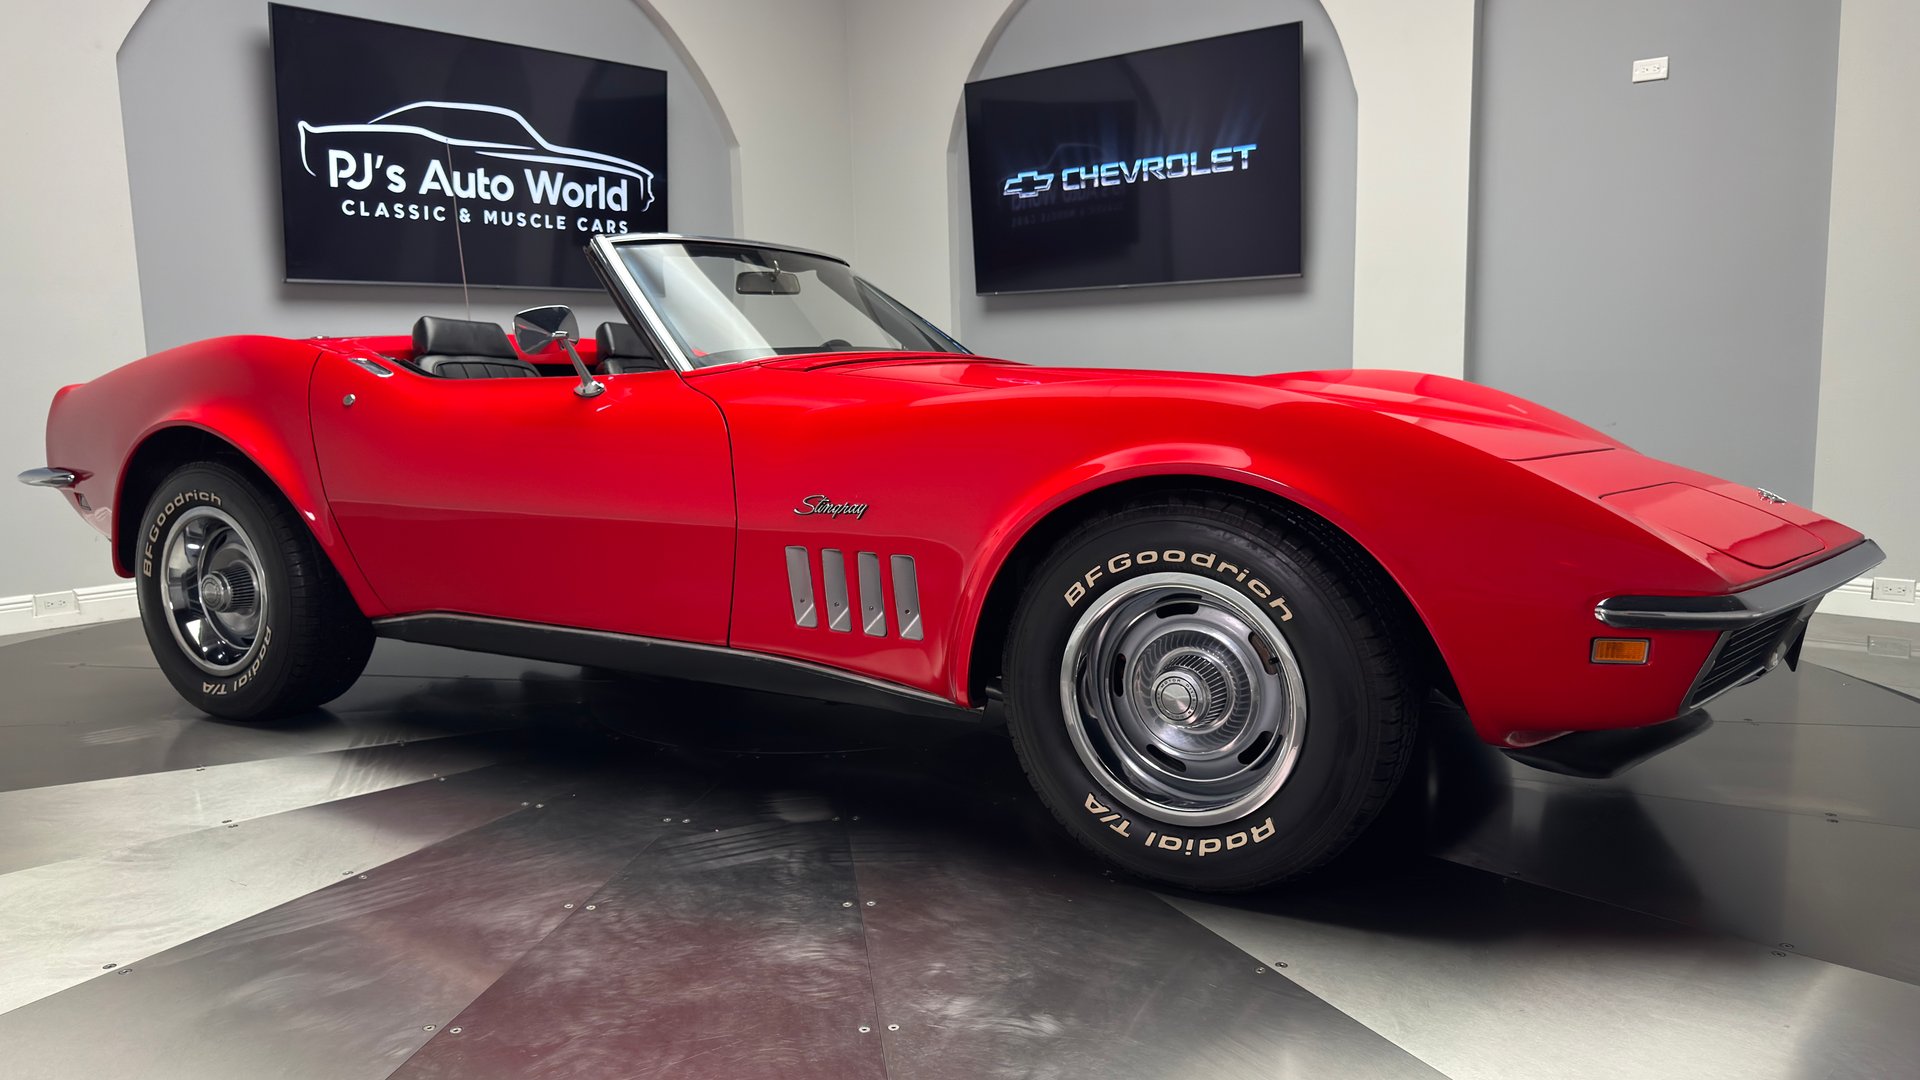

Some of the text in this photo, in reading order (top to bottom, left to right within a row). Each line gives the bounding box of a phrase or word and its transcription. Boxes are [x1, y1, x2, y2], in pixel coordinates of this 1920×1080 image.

[328, 149, 628, 212] PJ's Auto World
[1062, 144, 1257, 191] CHEVROLET
[341, 199, 628, 234] CLASSIC & MUSCLE CARS
[143, 489, 222, 578] BFGoodrich
[793, 494, 868, 520] Stingray
[1063, 549, 1294, 623] BFGoodrich
[203, 624, 272, 696] Radial T/A
[1084, 792, 1277, 858] Radial T/A
